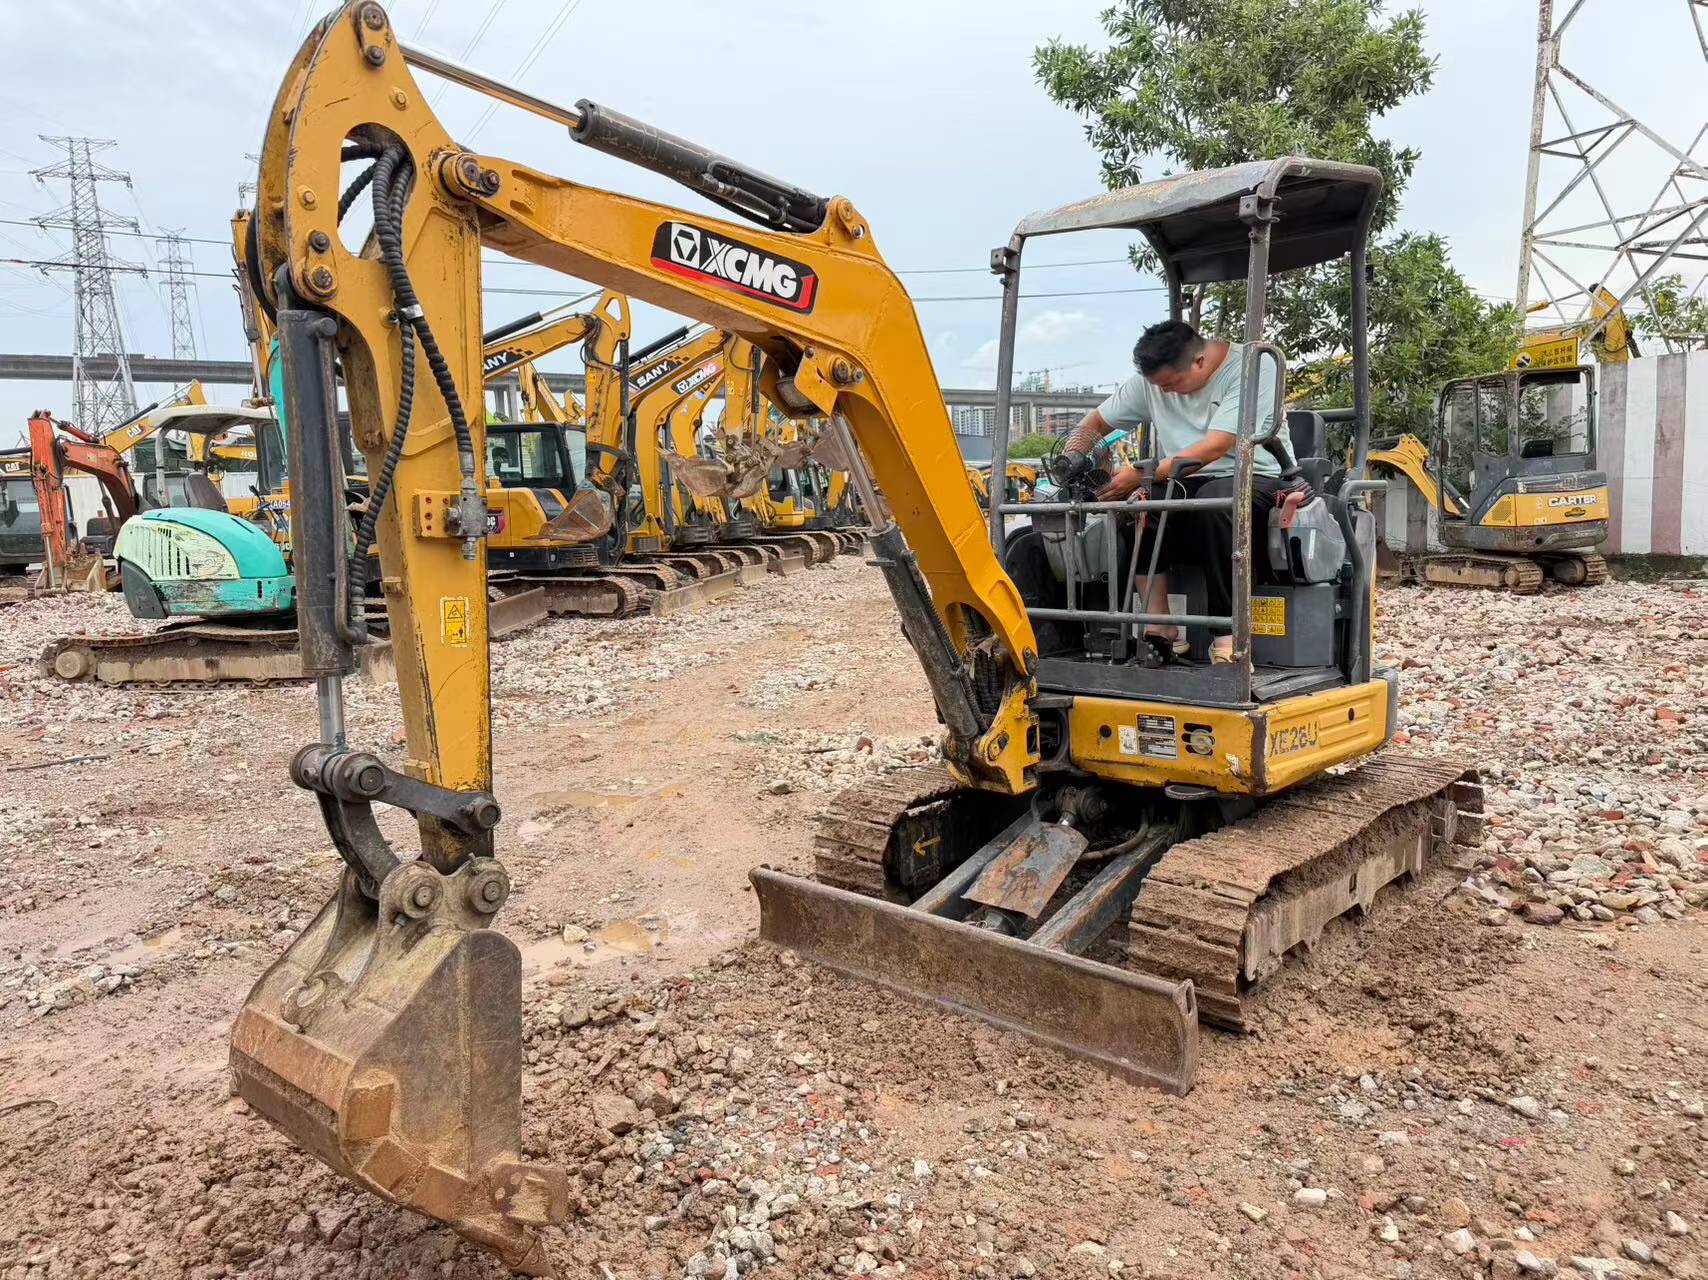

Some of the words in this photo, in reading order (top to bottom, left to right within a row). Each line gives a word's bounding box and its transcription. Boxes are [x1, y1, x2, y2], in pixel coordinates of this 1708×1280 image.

[700, 237, 797, 299] XCMG
[637, 361, 670, 388] SANY
[5, 462, 20, 472] CAT
[1549, 494, 1597, 507] CARTER
